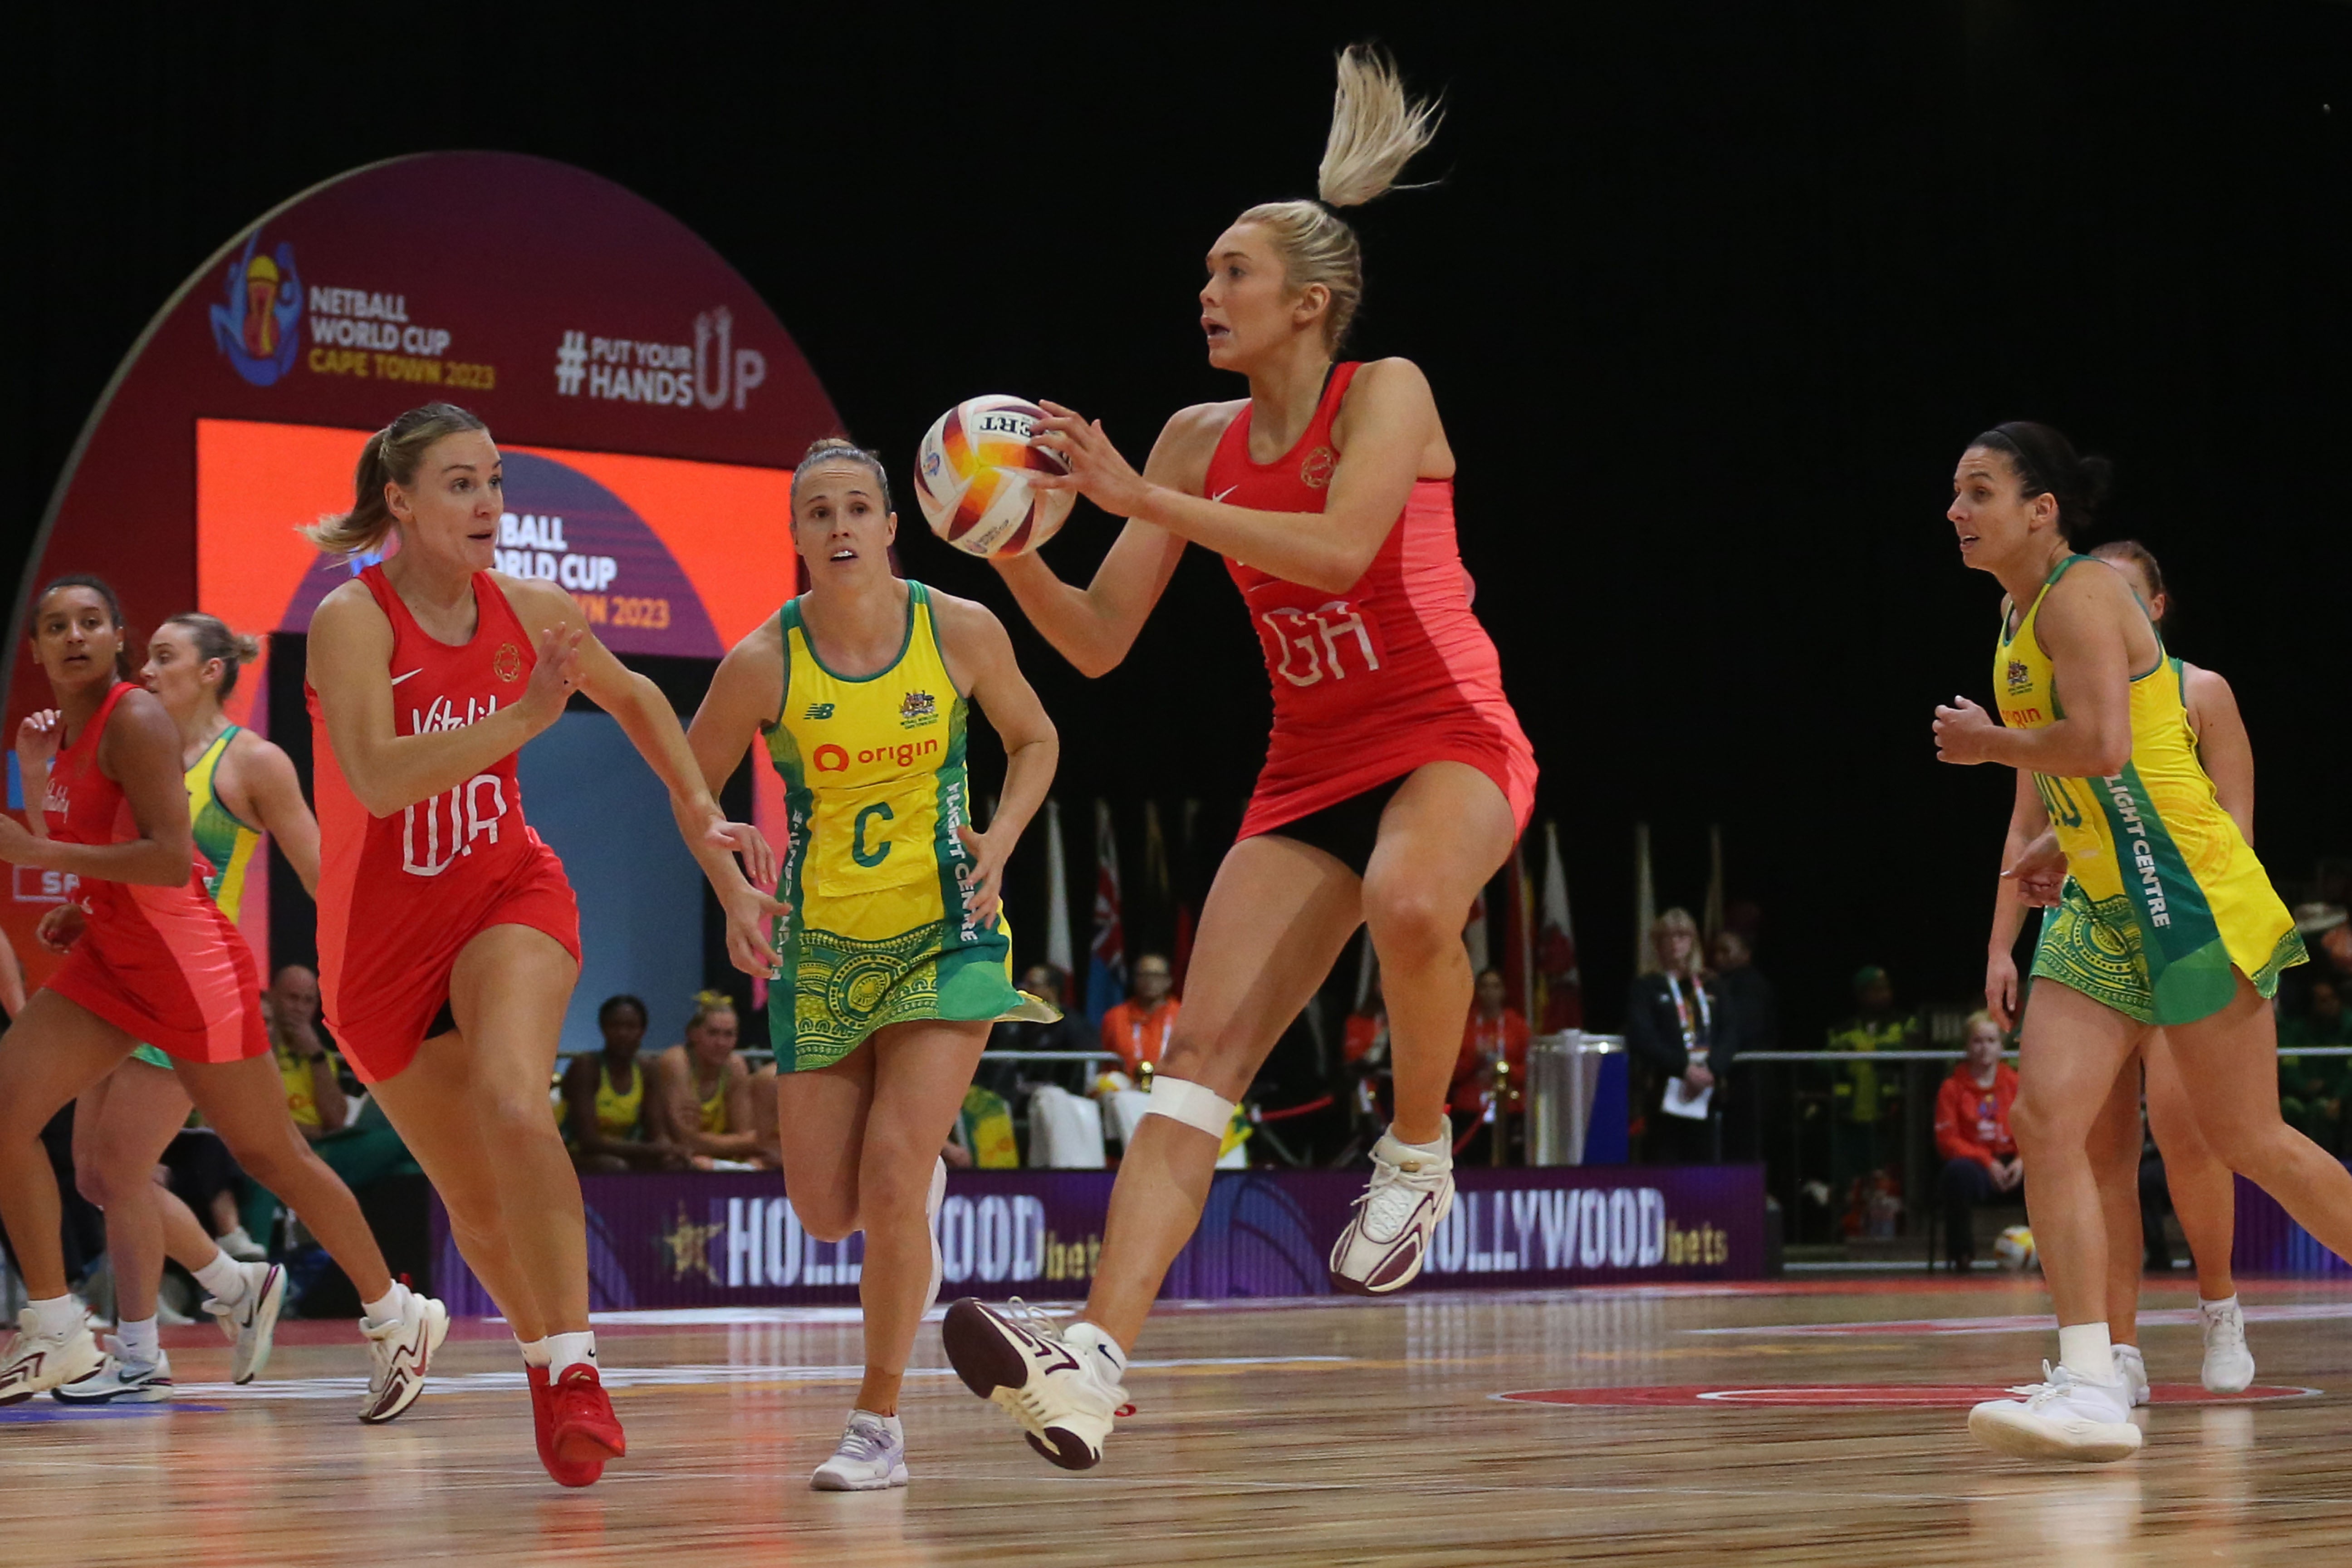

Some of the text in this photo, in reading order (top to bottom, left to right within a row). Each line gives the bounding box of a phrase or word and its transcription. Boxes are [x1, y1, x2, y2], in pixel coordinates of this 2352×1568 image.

[309, 285, 409, 323] NETBALL
[310, 316, 451, 356] WORLD CUP
[635, 341, 692, 370] YOUR
[309, 348, 495, 390] CAPE TOWN 2023
[590, 363, 694, 407] HANDS
[500, 512, 568, 552] BALL
[495, 549, 618, 591] RLD CUP
[613, 596, 670, 629] 2023
[858, 738, 938, 767] origin
[852, 801, 894, 868] C
[2102, 774, 2170, 929] LIGHT CENTRE
